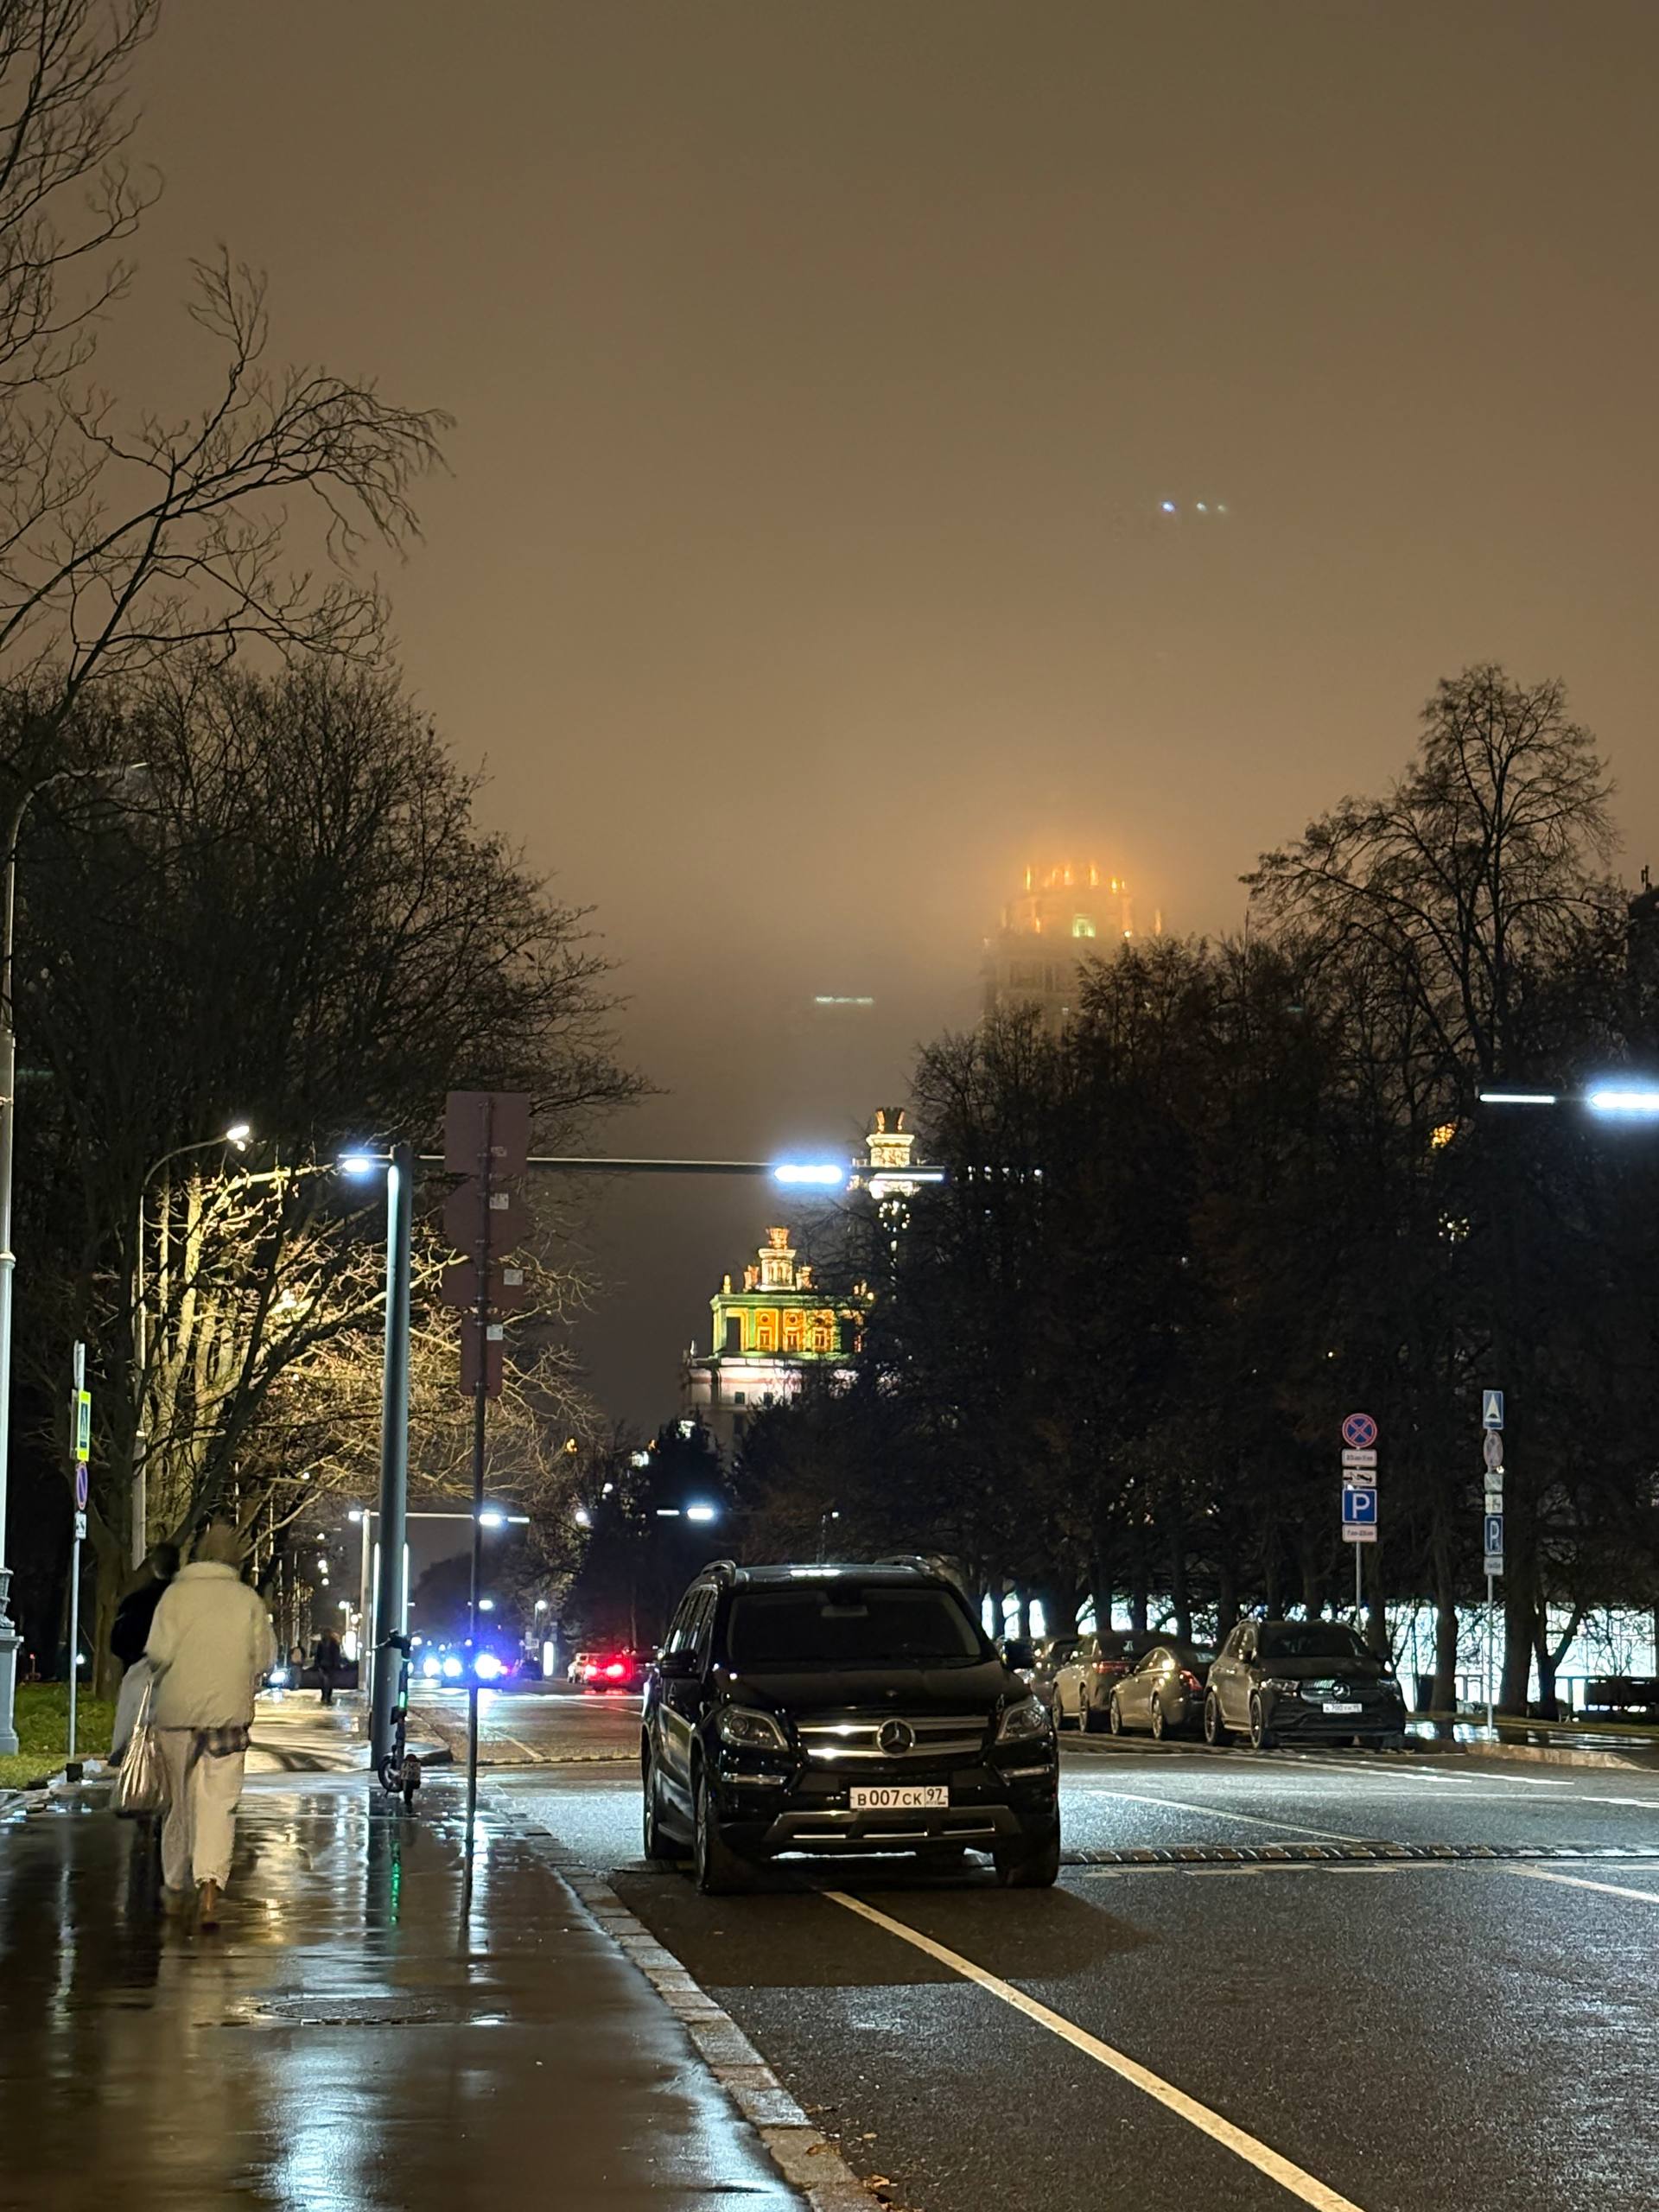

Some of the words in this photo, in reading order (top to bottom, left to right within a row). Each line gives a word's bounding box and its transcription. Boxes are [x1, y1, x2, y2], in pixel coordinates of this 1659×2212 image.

[1352, 1493, 1370, 1519] P
[857, 1789, 923, 1806] В007СК
[926, 1788, 943, 1802] 97
